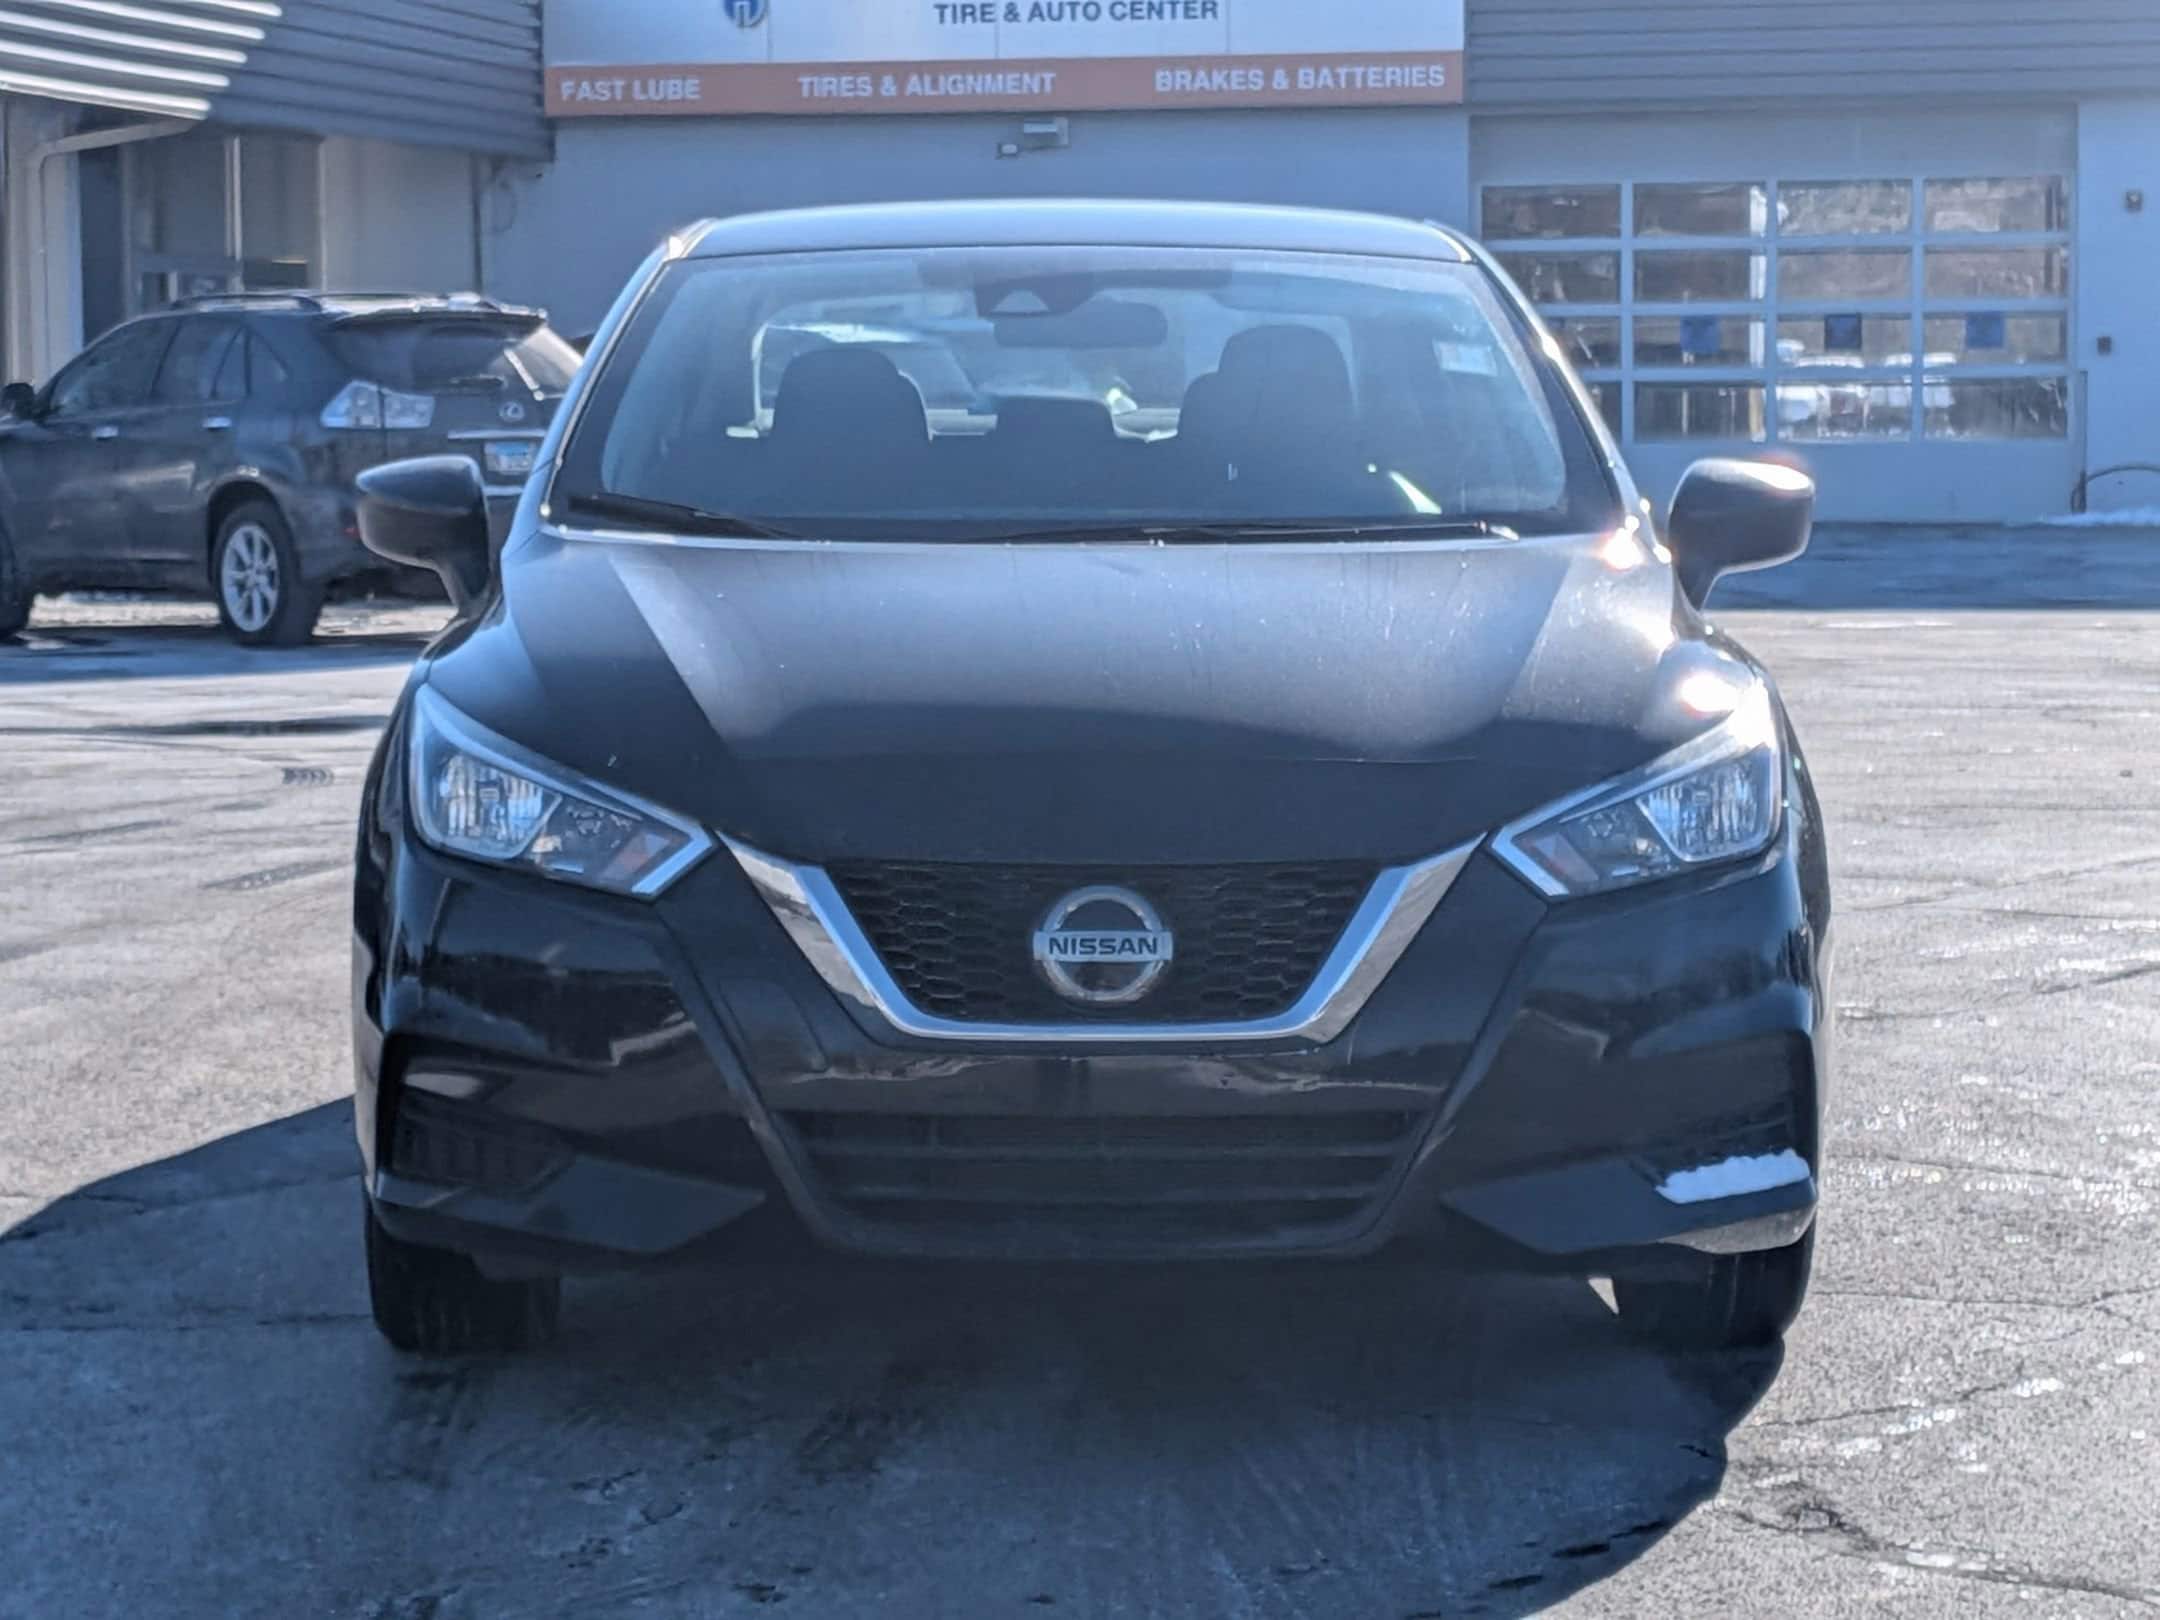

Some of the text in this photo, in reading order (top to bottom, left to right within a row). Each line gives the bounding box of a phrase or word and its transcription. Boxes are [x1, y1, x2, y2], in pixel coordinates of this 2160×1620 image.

[935, 0, 1219, 24] TIRE & AUTO CENTER
[561, 77, 701, 102] FAST LUBE
[798, 72, 1057, 97] TIRES & ALIGNMENT
[1155, 65, 1445, 92] BRAKES & BATTERIES
[1049, 937, 1158, 955] NISSAN
